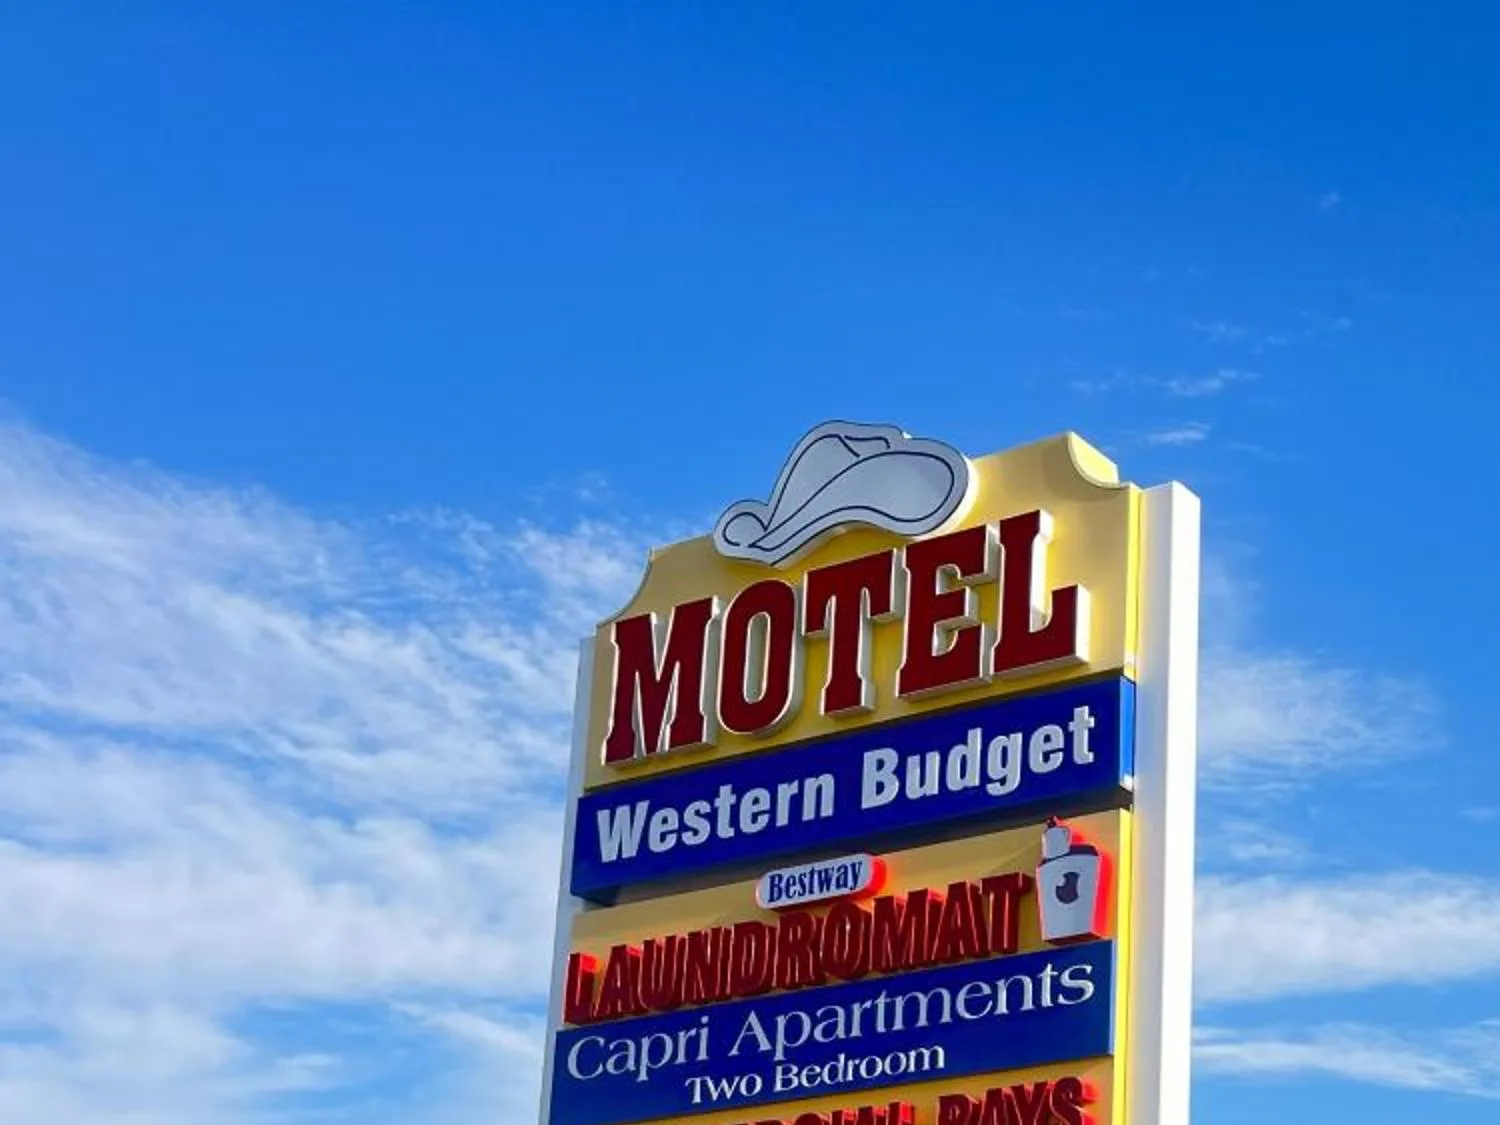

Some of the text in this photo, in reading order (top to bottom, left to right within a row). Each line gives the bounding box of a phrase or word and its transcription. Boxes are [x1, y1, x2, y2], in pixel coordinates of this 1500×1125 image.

[602, 508, 1083, 767] MOTEL
[597, 705, 1096, 862] Western Budget
[767, 855, 863, 902] Bestway
[563, 872, 1031, 1025] LAUNDROMAT
[567, 961, 1095, 1084] Capri Apartments
[686, 1043, 945, 1103] Two Bedroom
